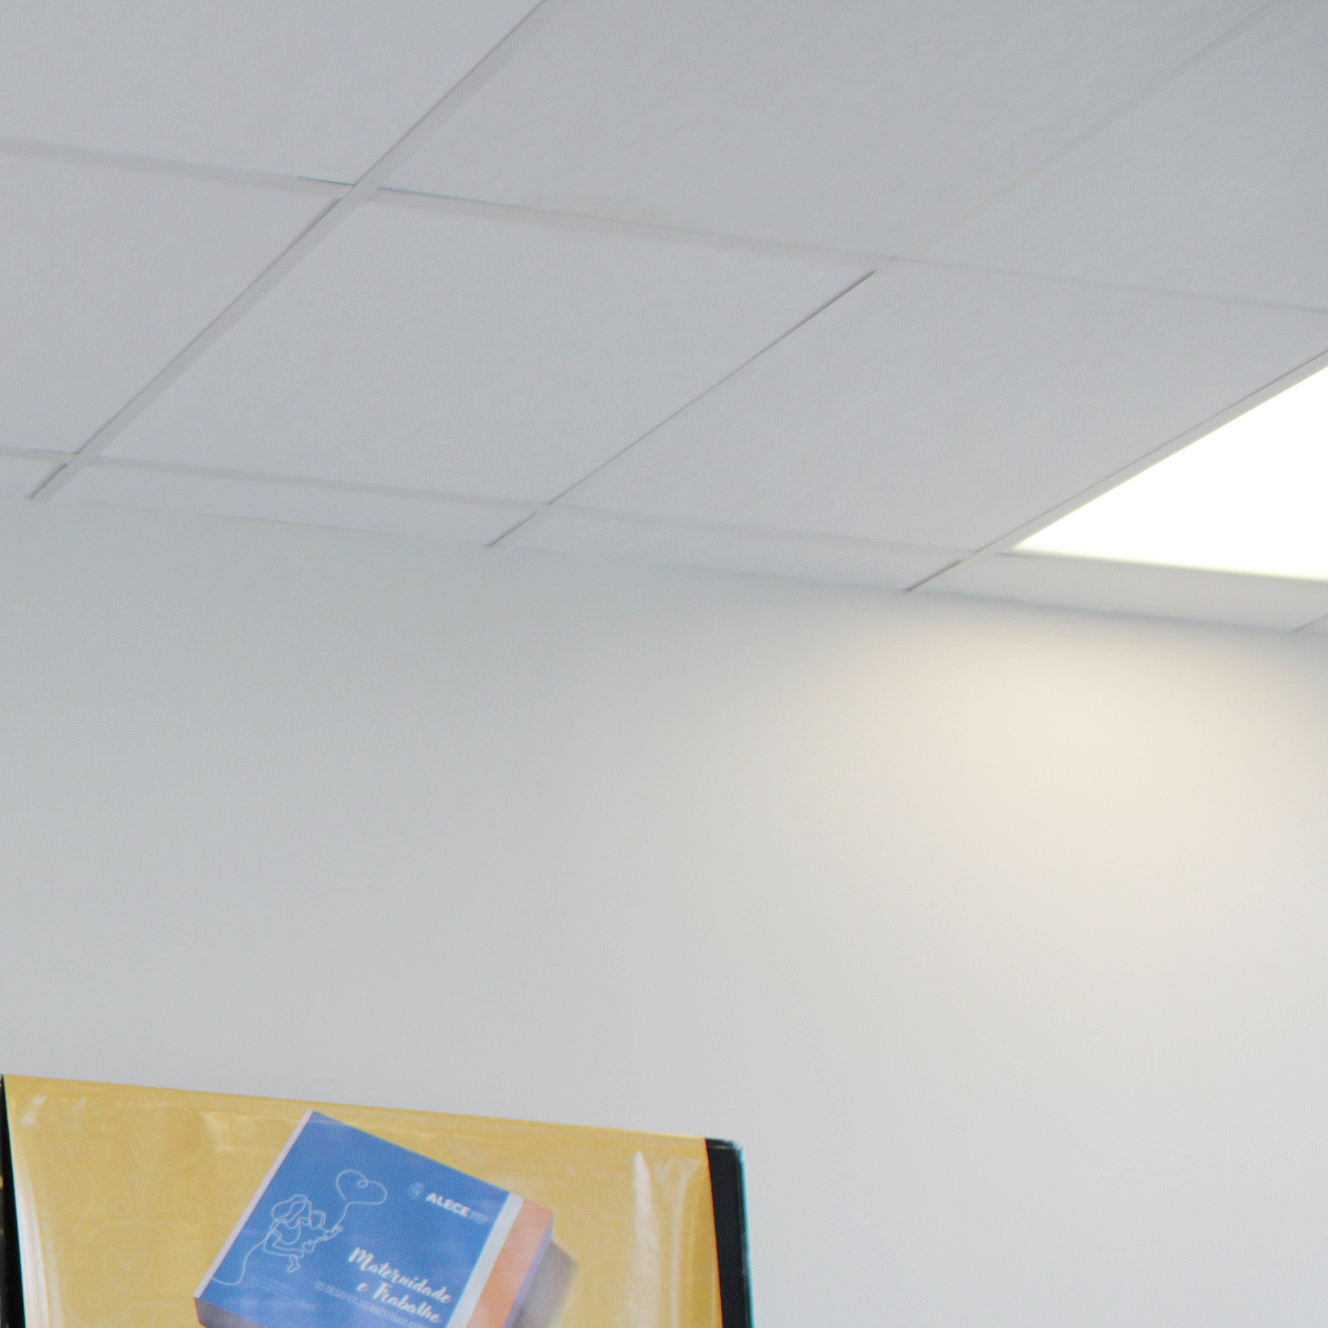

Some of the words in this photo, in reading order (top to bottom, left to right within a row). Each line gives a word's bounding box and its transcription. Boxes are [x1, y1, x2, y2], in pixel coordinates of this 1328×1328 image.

[425, 1192, 471, 1218] ALECE
[347, 1247, 453, 1304] Maternidade
[373, 1280, 442, 1323] Trabalho
